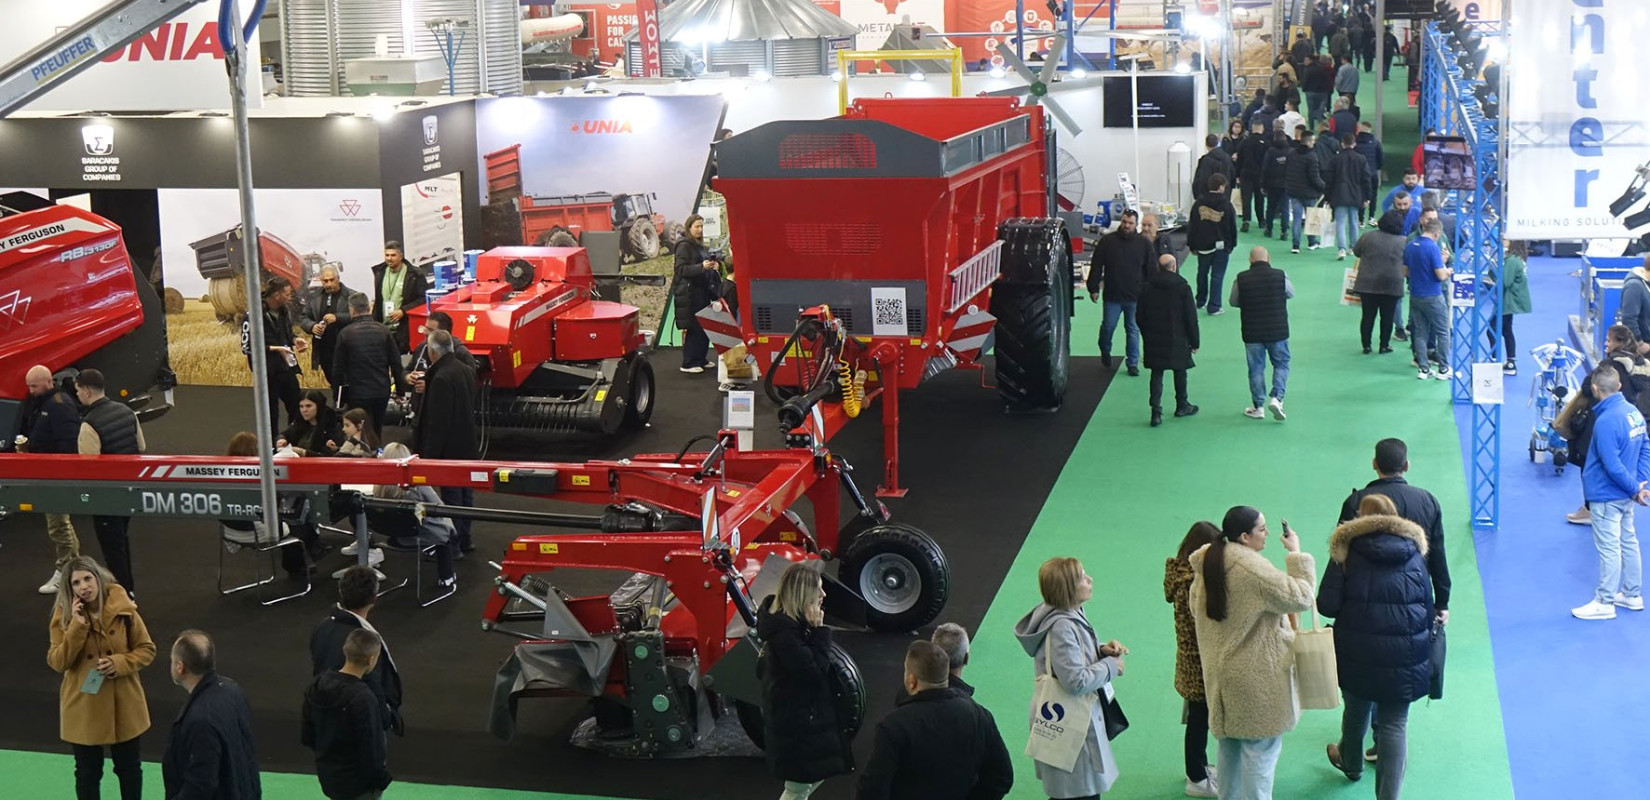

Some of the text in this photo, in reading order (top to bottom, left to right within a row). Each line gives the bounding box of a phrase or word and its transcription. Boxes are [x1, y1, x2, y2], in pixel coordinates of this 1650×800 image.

[606, 15, 639, 25] PASSIO
[607, 26, 624, 36] FOR
[857, 23, 893, 33] META
[608, 37, 625, 47] CAL
[31, 36, 95, 81] PFEUFFER
[1569, 0, 1605, 208] nter
[584, 119, 633, 134] UNIA
[81, 157, 120, 165] SARACAKIS
[1517, 216, 1623, 228] MILKING SOLUTI
[9, 223, 66, 247] FERGUSON
[185, 467, 280, 480] MASSEY FERGUN
[142, 492, 176, 513] DM
[180, 493, 222, 515] 306
